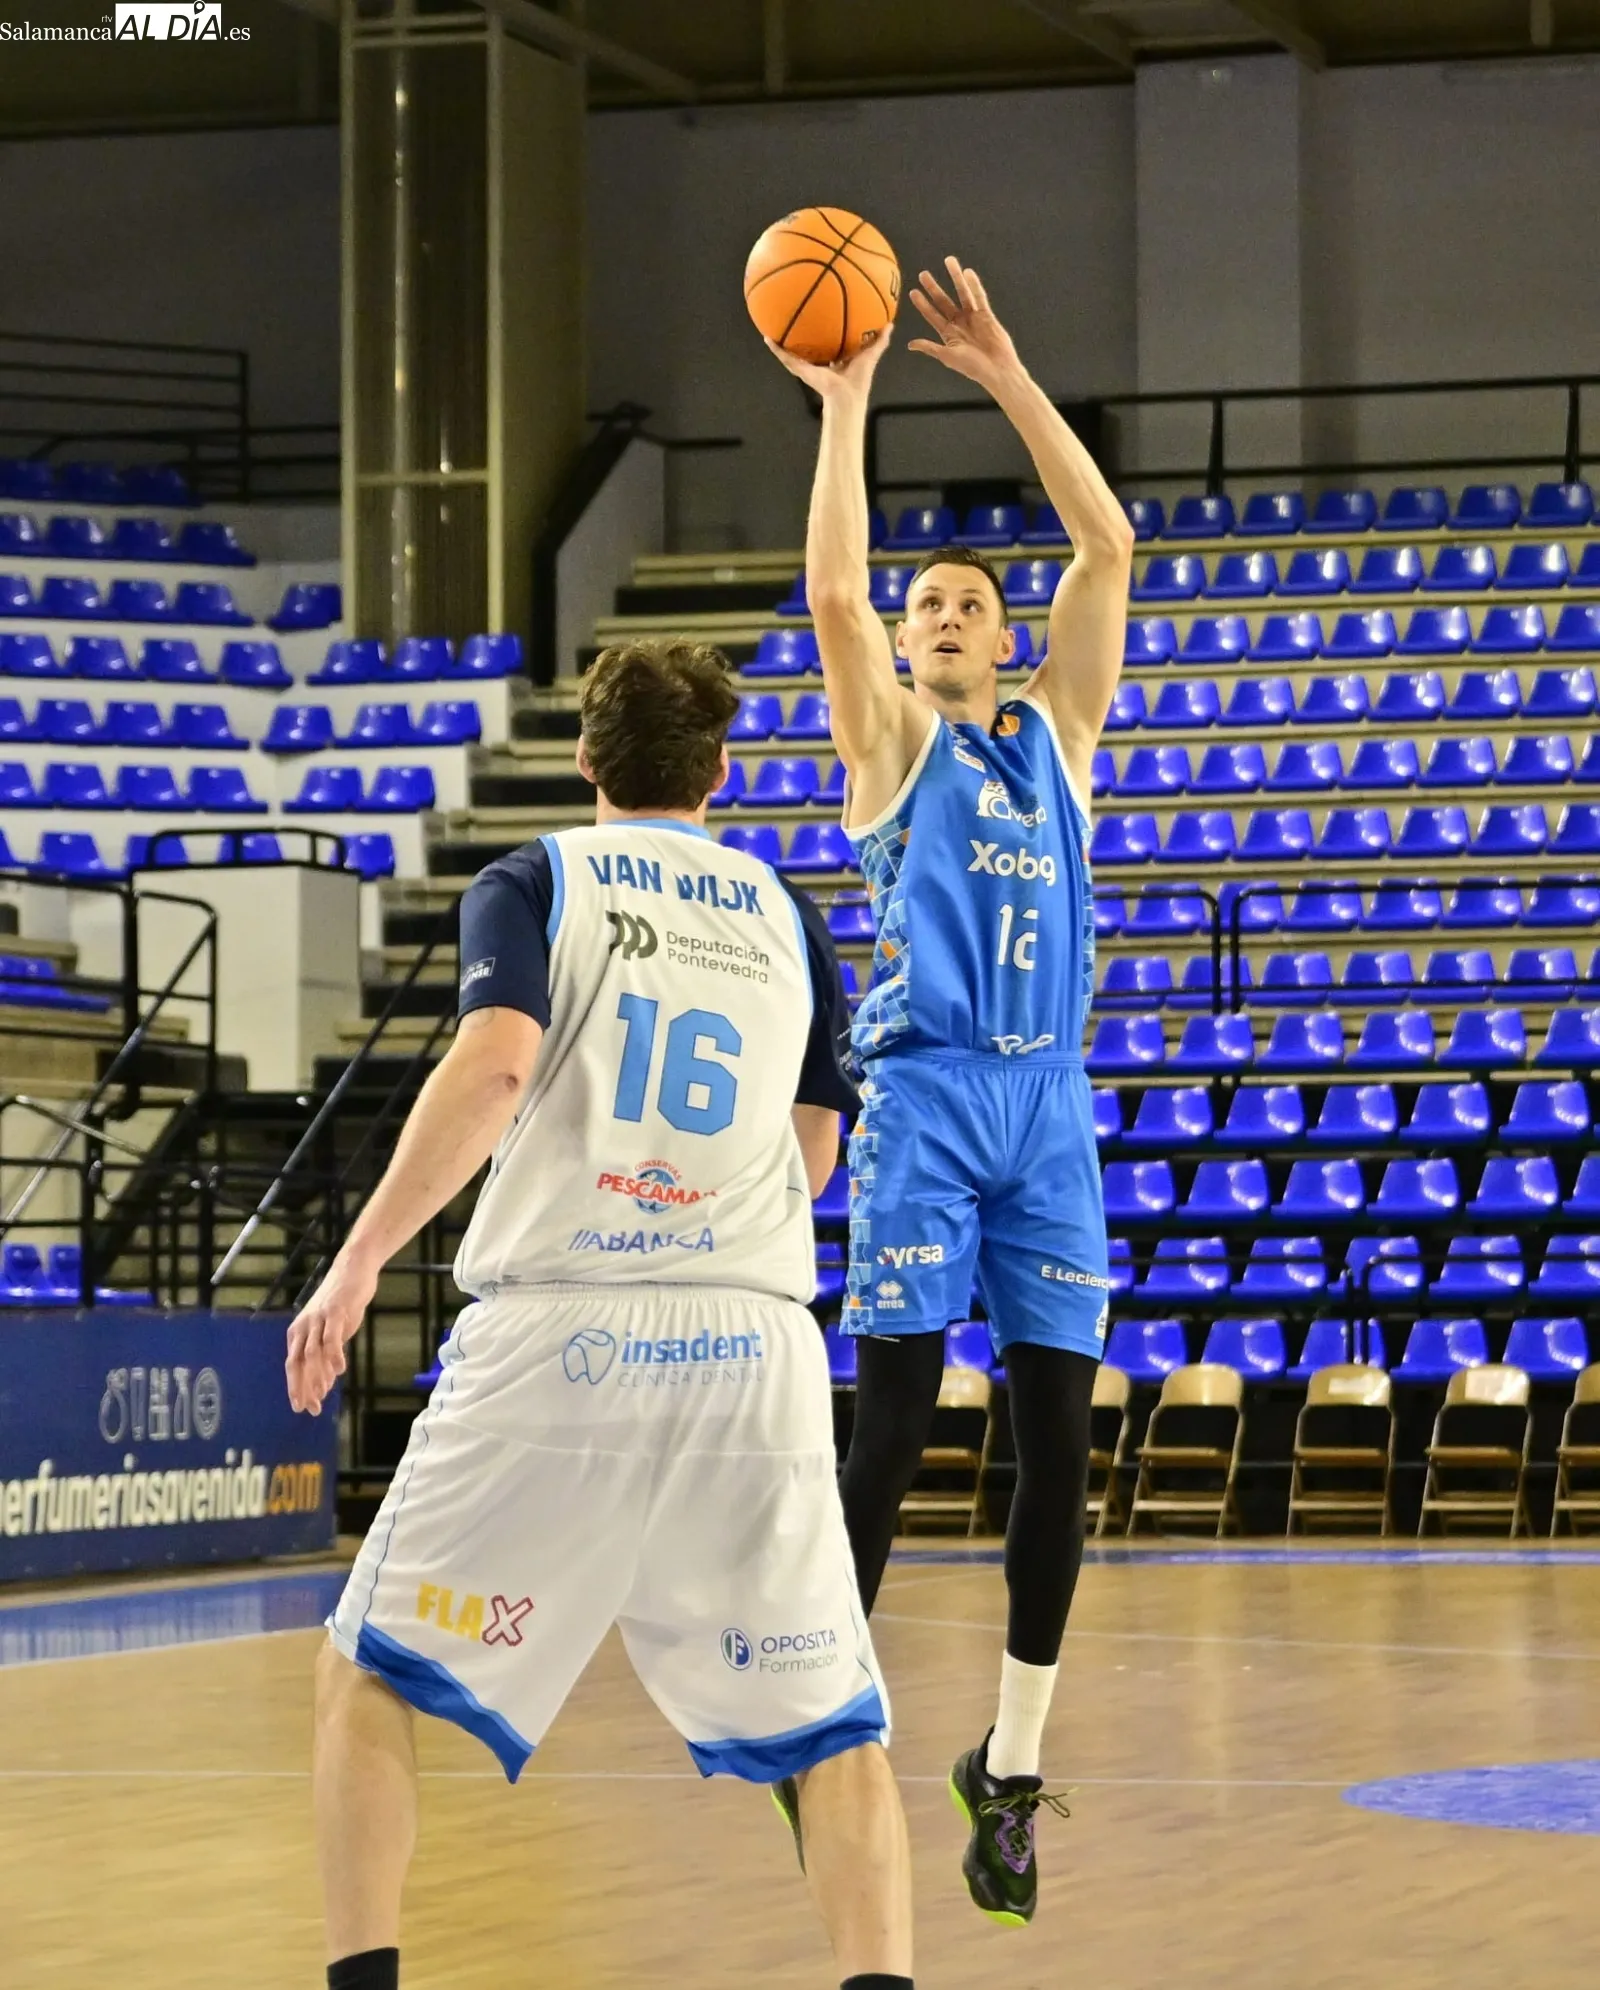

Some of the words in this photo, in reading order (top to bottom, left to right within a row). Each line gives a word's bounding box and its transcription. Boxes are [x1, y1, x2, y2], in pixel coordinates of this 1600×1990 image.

[587, 854, 663, 894] VAN
[674, 871, 765, 916] WIJK
[666, 931, 770, 966] Deputación
[667, 948, 769, 984] Pontevedra
[613, 992, 742, 1136] 16
[596, 1172, 718, 1205] PESCAMA
[621, 1328, 763, 1364] insadent
[416, 1582, 535, 1647] FLAX
[761, 1629, 837, 1654] OPOSITA
